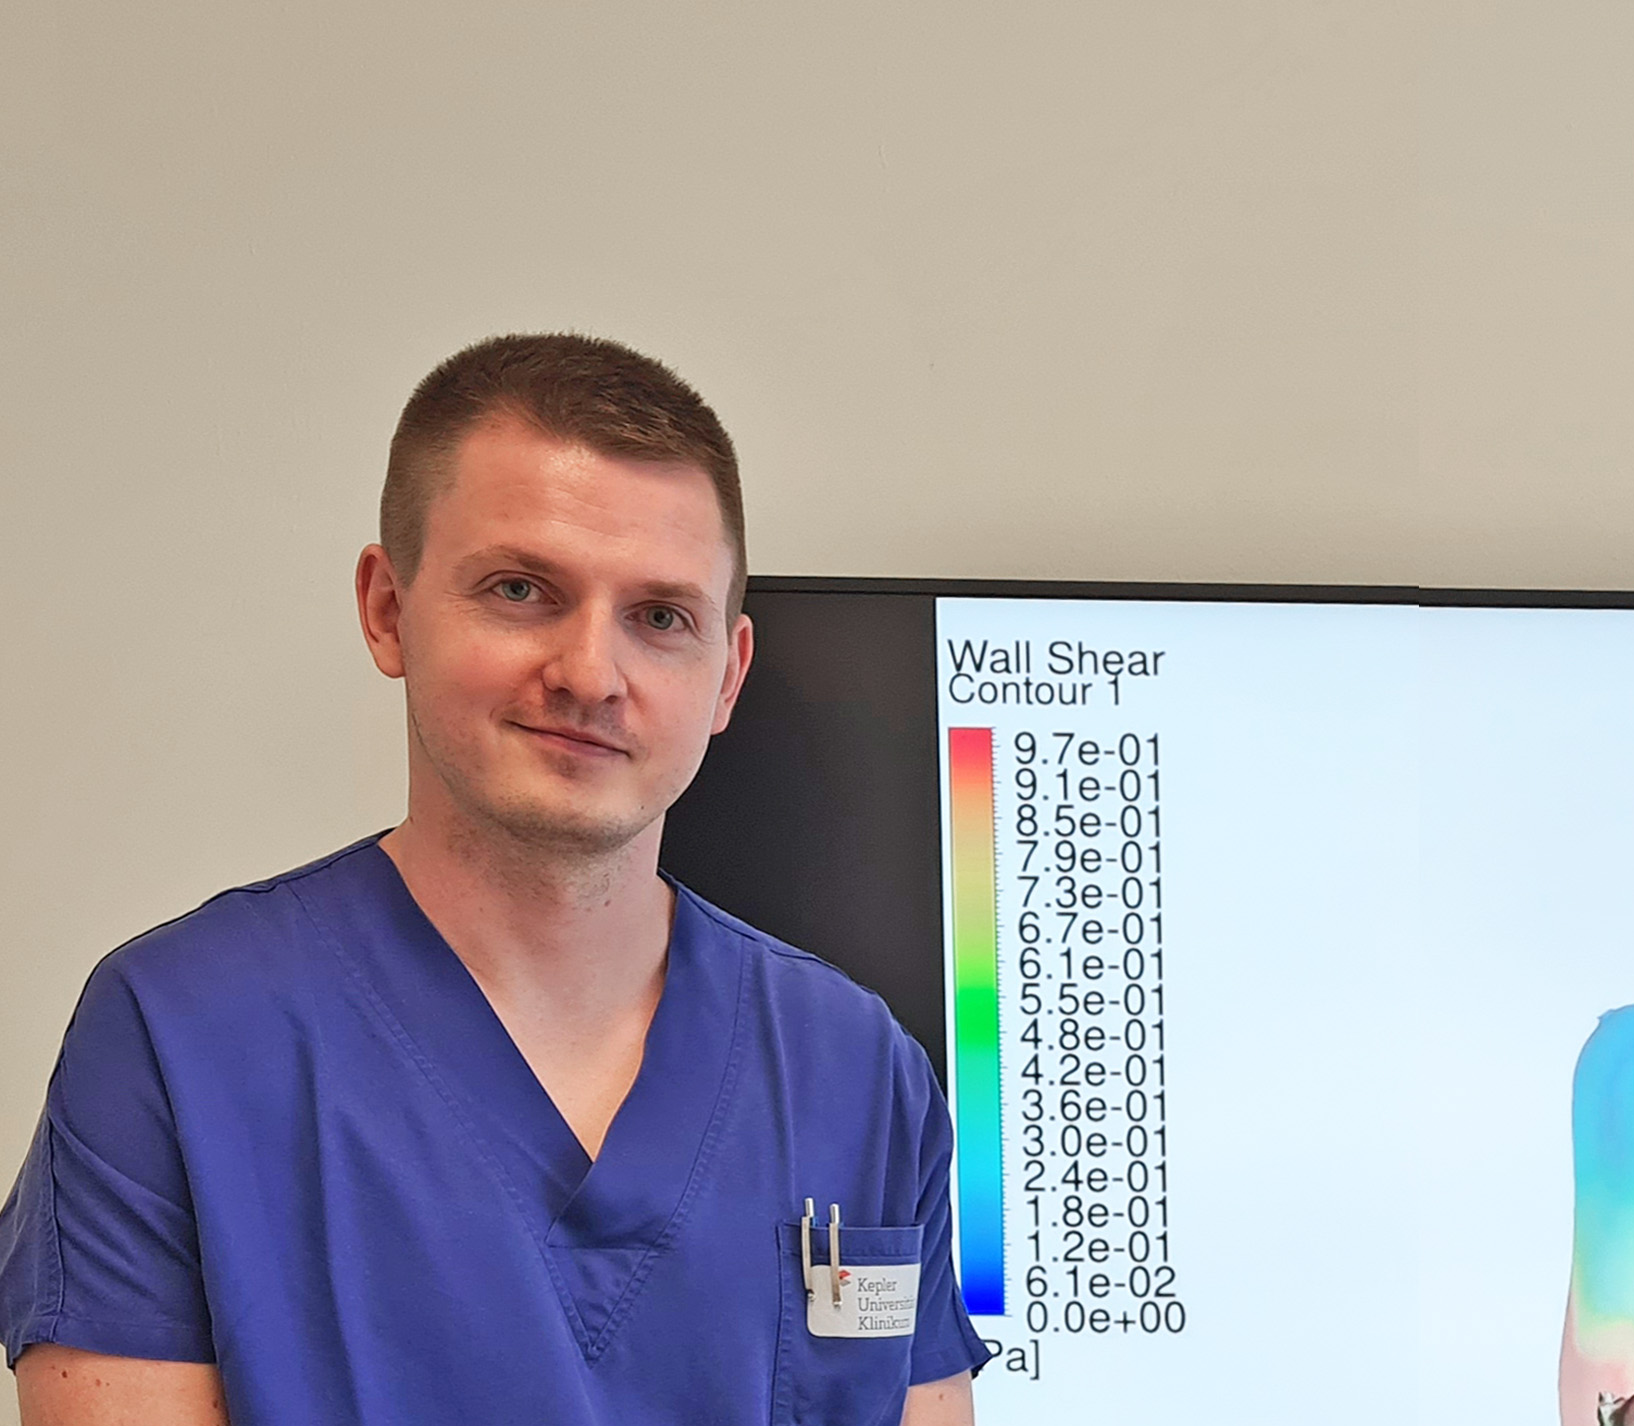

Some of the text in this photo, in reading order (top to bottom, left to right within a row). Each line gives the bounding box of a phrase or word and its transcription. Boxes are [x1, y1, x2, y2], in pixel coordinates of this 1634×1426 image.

[947, 639, 1165, 676] Wall Shear
[948, 673, 1120, 705] Contour 1
[1015, 732, 1158, 766] 9.7e-01
[1015, 768, 1159, 802] 9.1e-01
[1016, 804, 1160, 838] 8.5e-01
[1017, 840, 1160, 873] 7.9e-01
[1018, 876, 1161, 909] 7.3e-01
[1019, 911, 1161, 944] 6.7e-01
[1020, 947, 1162, 980] 6.1e-01
[1021, 983, 1163, 1016] 5.5e-01
[1021, 1018, 1163, 1051] 4.8e-01
[1021, 1054, 1164, 1086] 4.2e-01
[1022, 1089, 1165, 1122] 3.6e-01
[1023, 1124, 1165, 1157] 3.0e-01
[1024, 1160, 1166, 1192] 2.4e-01
[1027, 1195, 1167, 1227] 1.8e-01
[1028, 1230, 1167, 1263] 1.2e-01
[858, 1277, 897, 1296] Kepler
[1027, 1266, 1175, 1298] 6.1e-02
[1027, 1301, 1185, 1333] 0.0e+00
